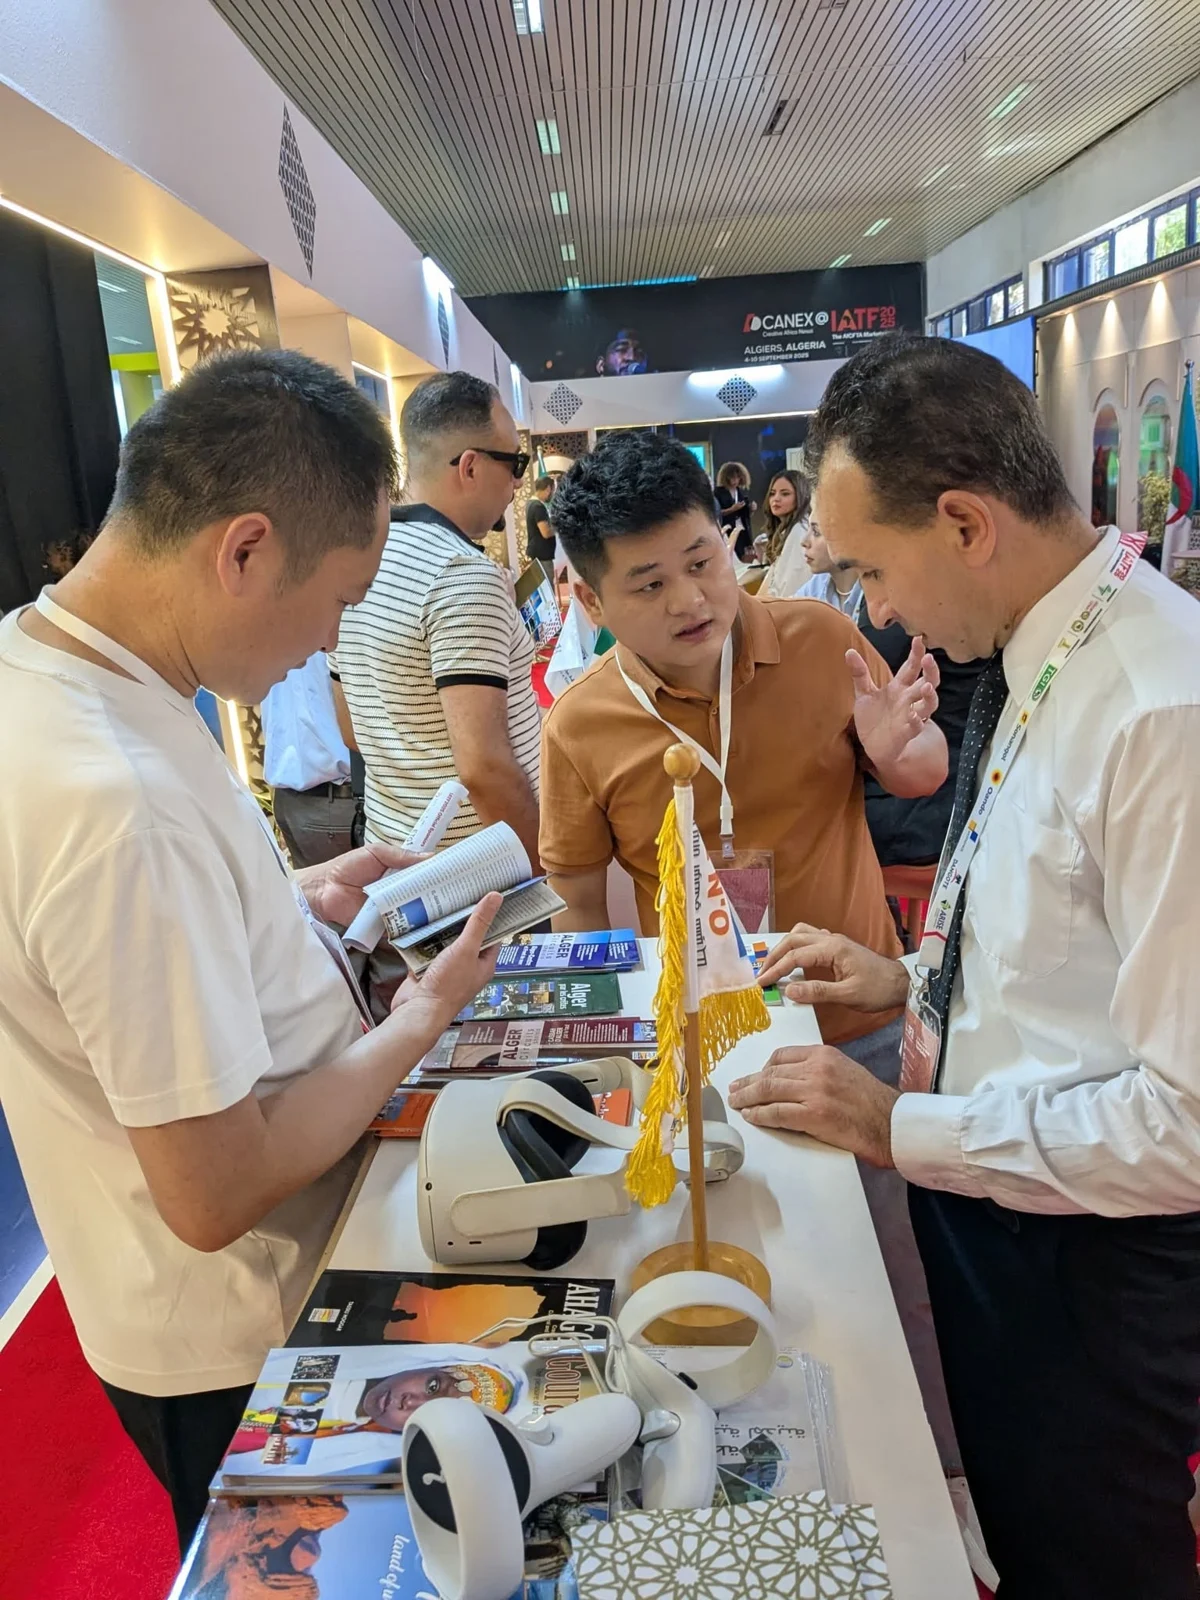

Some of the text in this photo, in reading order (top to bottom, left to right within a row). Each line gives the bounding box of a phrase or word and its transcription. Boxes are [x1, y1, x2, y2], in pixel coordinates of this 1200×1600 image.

[762, 312, 814, 330] CANEX
[831, 307, 879, 332] IATF
[758, 353, 793, 362] SEPTEMBER
[785, 340, 826, 352] ALGERIA
[1041, 666, 1056, 688] TGI
[1001, 724, 1022, 762] Sonangol
[978, 786, 993, 816] Oando
[431, 811, 443, 828] Official
[421, 827, 435, 847] Sponsors
[942, 858, 958, 889] DANGOTE
[707, 871, 730, 936] O.N
[936, 910, 947, 931] ARISE
[555, 934, 575, 959] ALGER
[567, 983, 591, 1008] Alger
[502, 1028, 523, 1060] ALGER
[518, 1028, 536, 1061] Circuits
[389, 1534, 410, 1573] land
[379, 1573, 401, 1590] of
